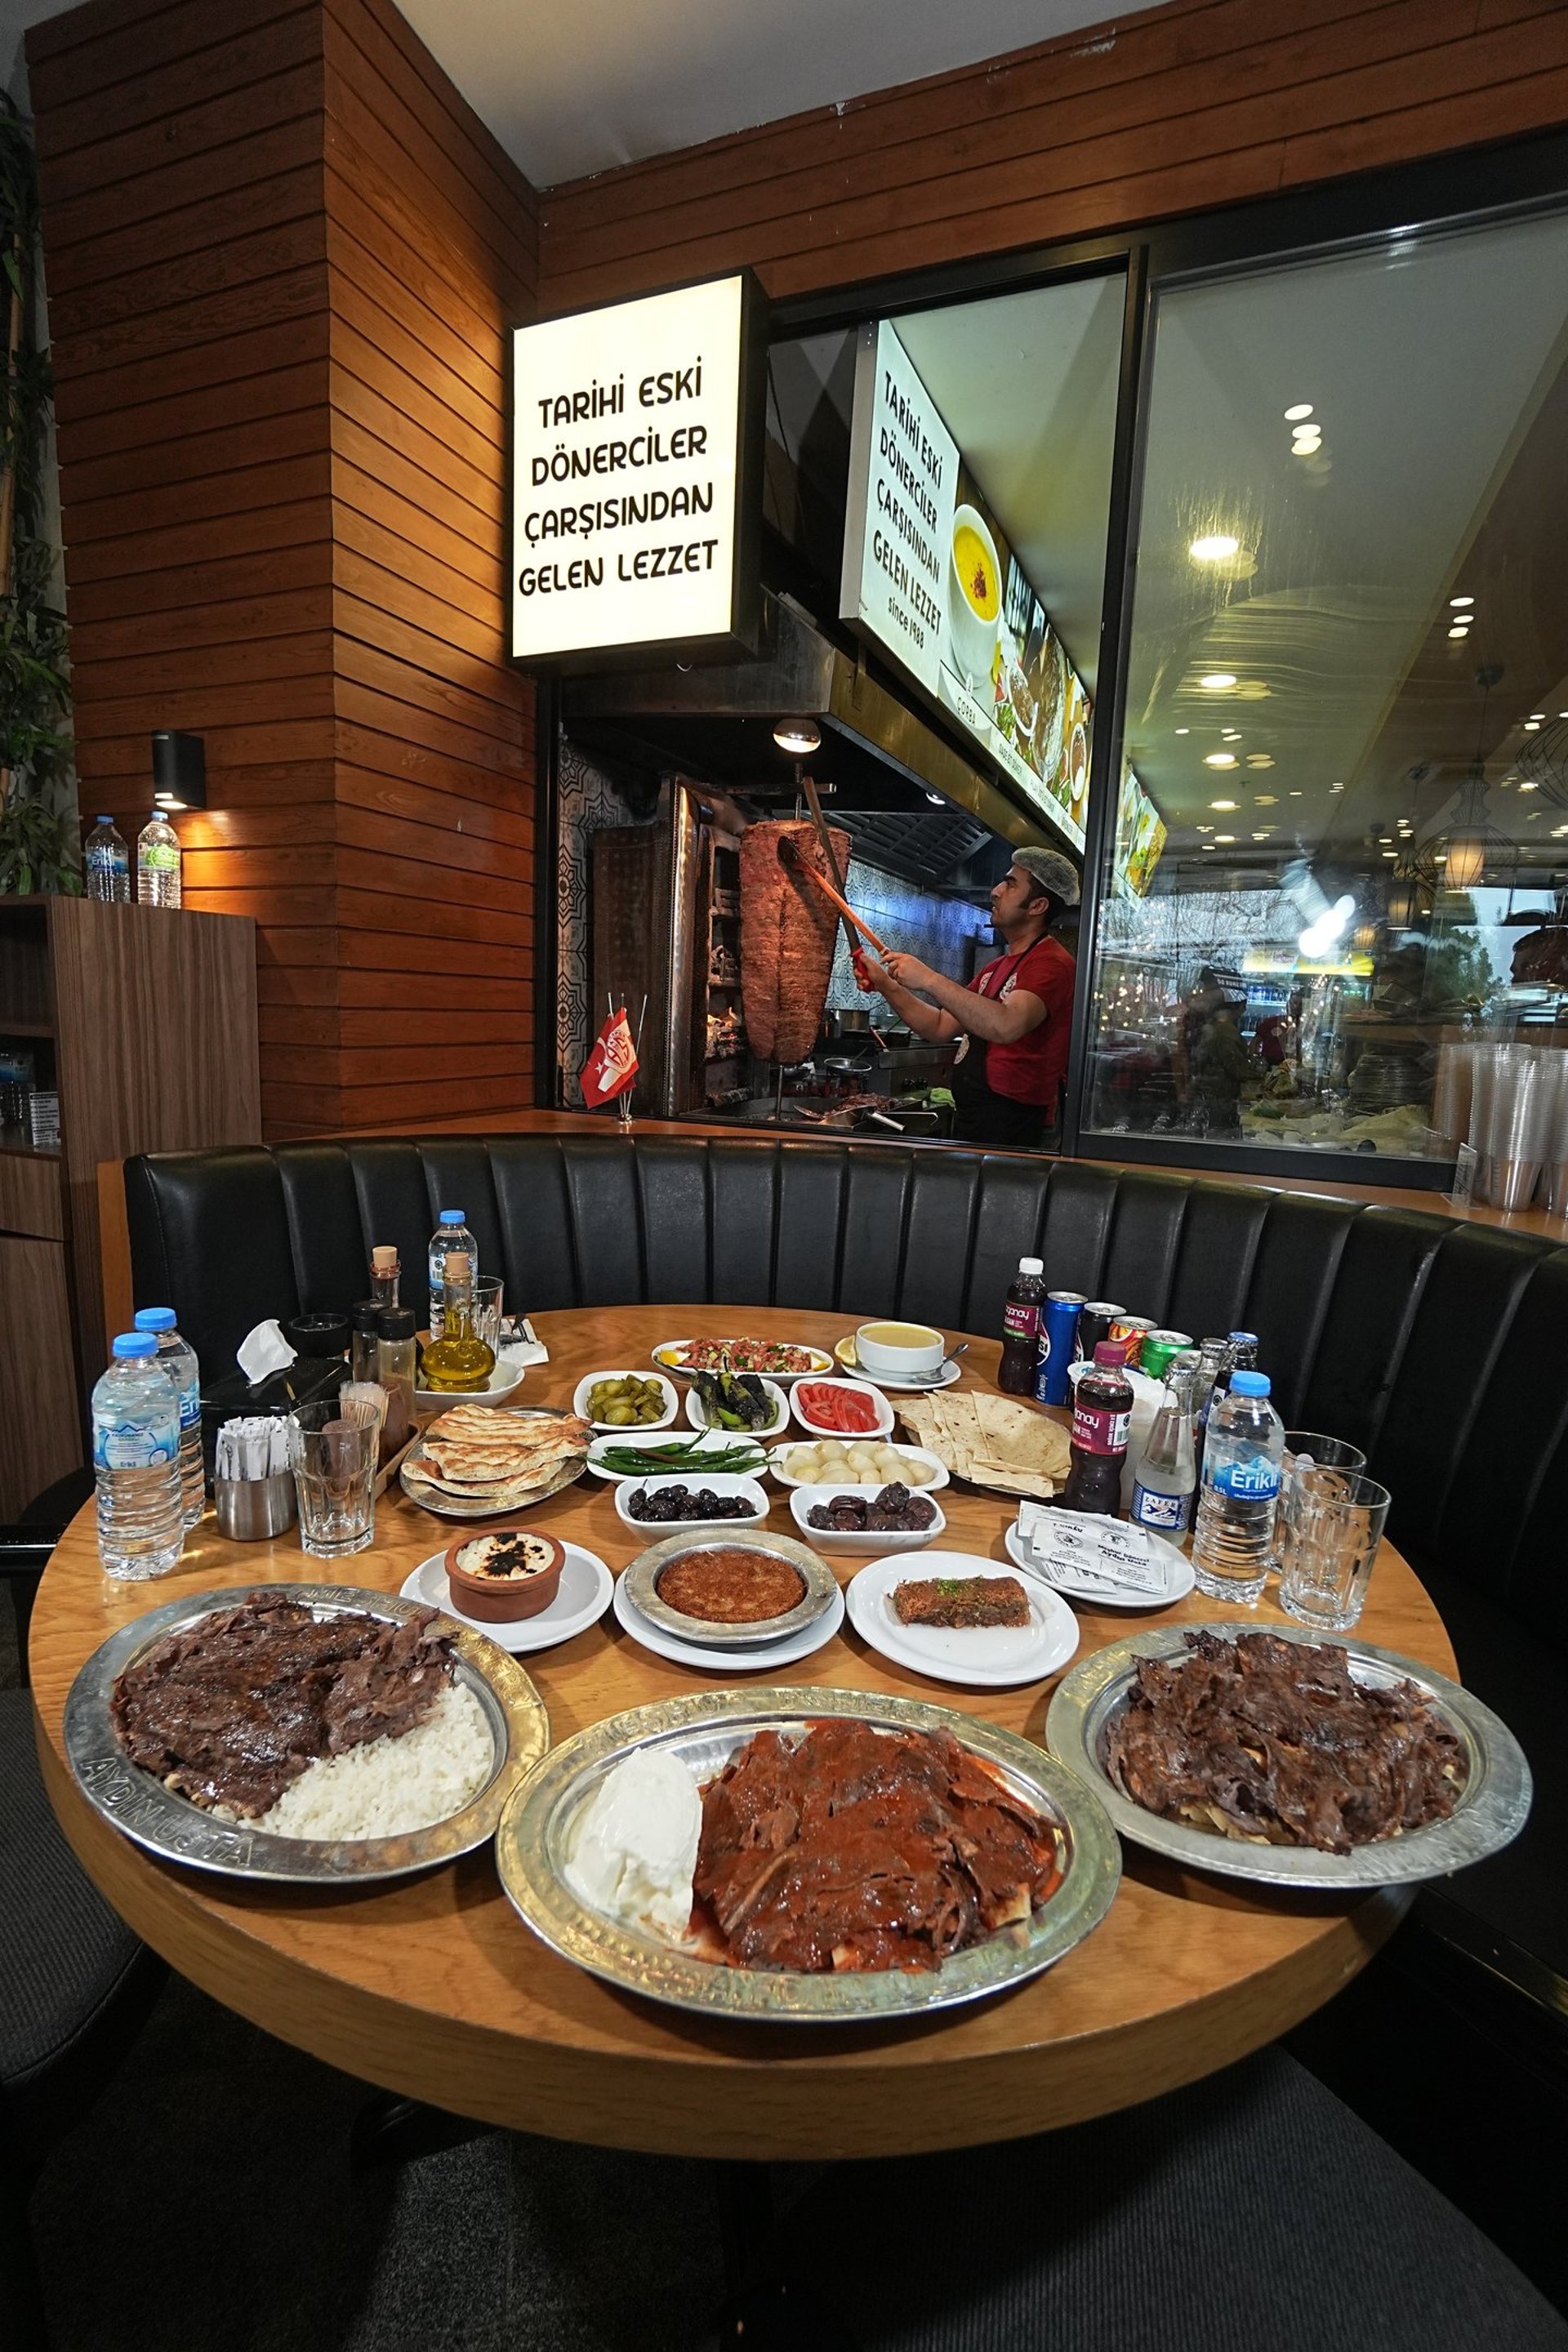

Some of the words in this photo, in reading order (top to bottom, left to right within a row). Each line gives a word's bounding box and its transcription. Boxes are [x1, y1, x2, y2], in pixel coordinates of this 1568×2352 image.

[539, 373, 623, 428] TARİHİ
[639, 356, 701, 407] ESKİ
[532, 425, 706, 486] DÖNERCİLER
[885, 371, 920, 452] TARİHİ
[921, 435, 942, 489] ESKİ
[880, 426, 937, 532] DÖNERCİLER
[525, 483, 712, 548] ÇARŞISINDAN
[877, 479, 940, 584] ÇARŞISINDAN
[519, 558, 603, 596] GELEN
[618, 540, 718, 581] LEZZET
[874, 529, 908, 596] GELEN
[910, 577, 942, 635] LEZZET
[889, 597, 908, 631] since
[910, 618, 924, 649] 1988
[956, 696, 976, 728] ÇORBA
[1145, 1495, 1176, 1508] ZAFER
[81, 1757, 166, 1826] AYDIN
[153, 1813, 254, 1867] USTA
